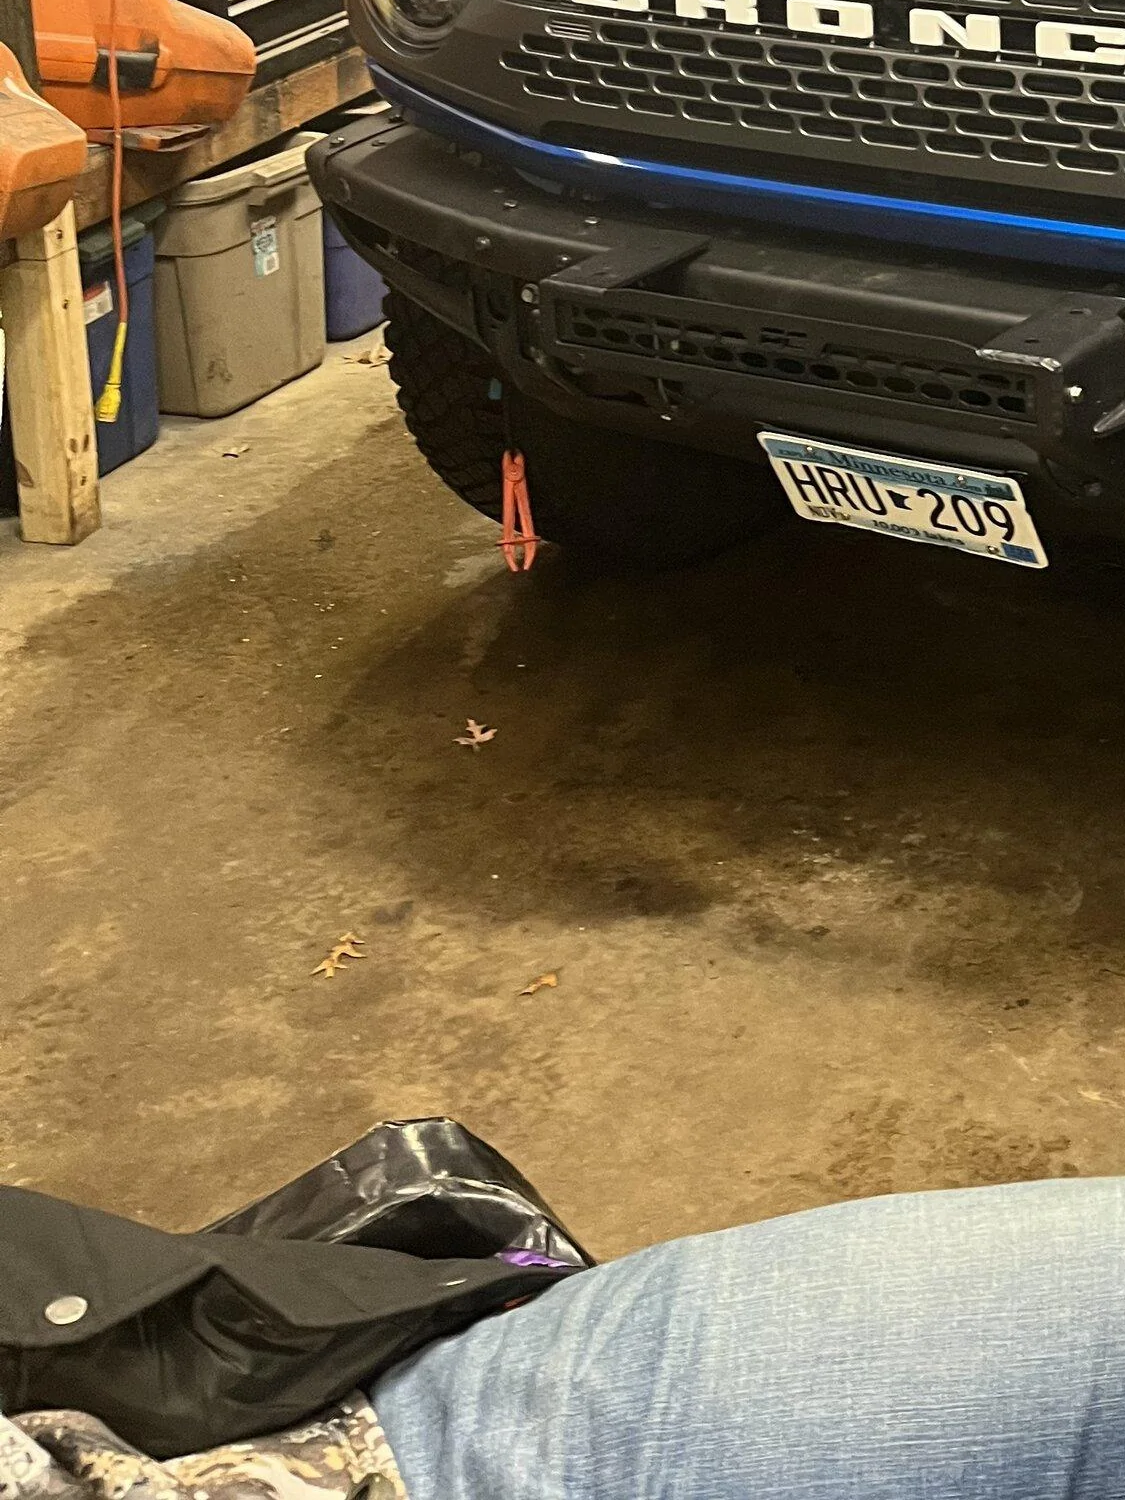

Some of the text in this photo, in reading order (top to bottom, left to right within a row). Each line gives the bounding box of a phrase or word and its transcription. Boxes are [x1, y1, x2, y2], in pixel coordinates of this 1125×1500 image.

[827, 450, 947, 485] Minnesota
[783, 461, 1015, 542] HRU 209
